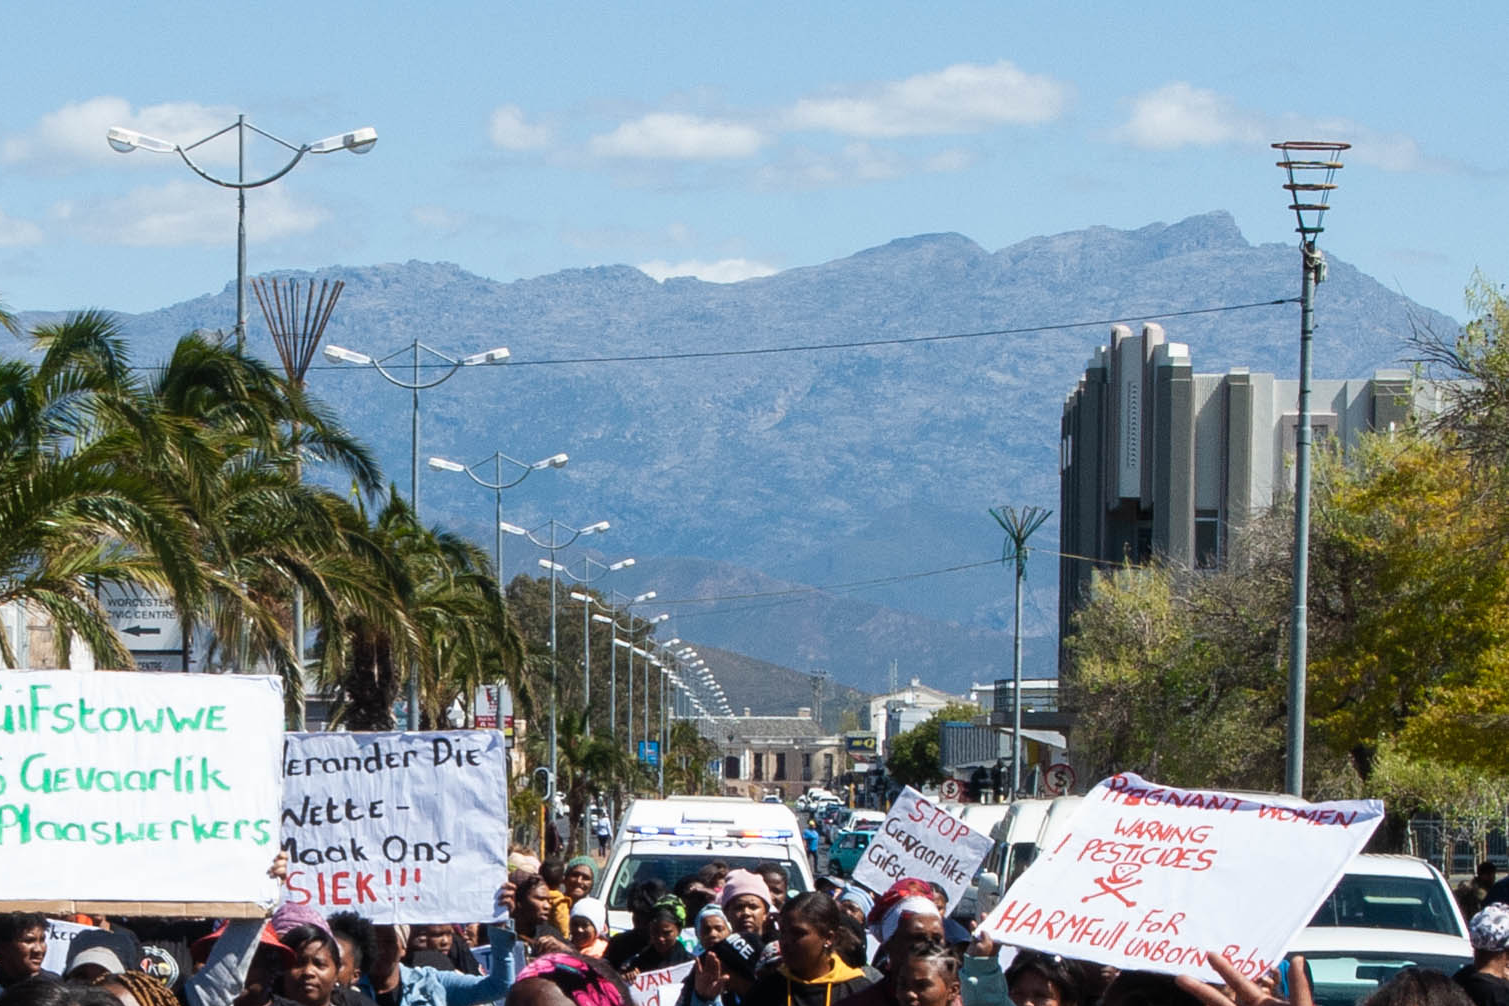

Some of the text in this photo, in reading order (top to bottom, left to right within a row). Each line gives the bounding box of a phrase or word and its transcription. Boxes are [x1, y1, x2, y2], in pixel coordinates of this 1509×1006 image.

[134, 610, 176, 619] CENTRE
[908, 799, 970, 843] STOP
[1258, 803, 1358, 829] WOMEN
[1114, 817, 1214, 844] WARNING
[382, 836, 452, 864] Ons
[1077, 838, 1217, 872] PESTICIDES
